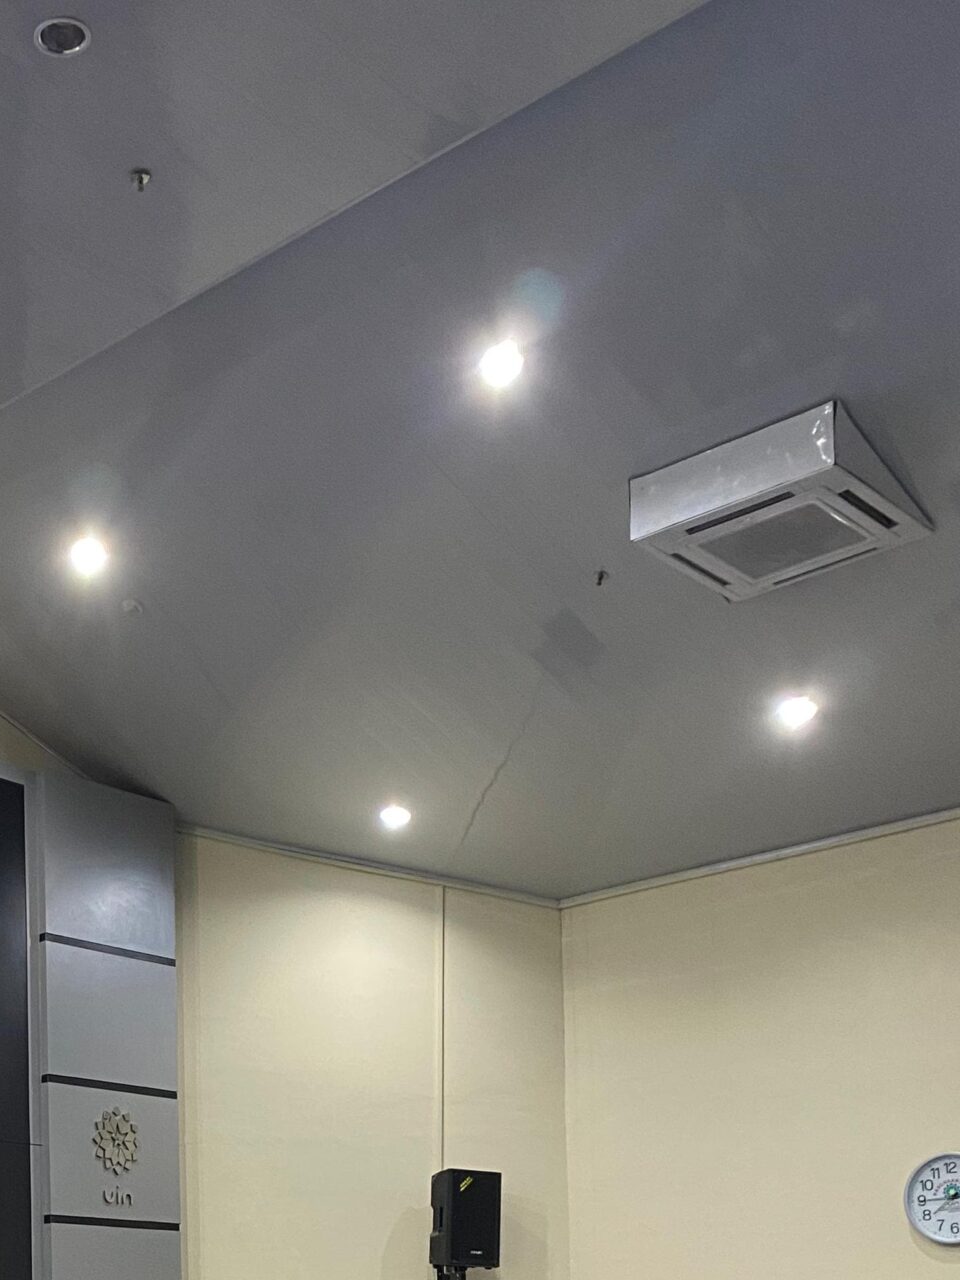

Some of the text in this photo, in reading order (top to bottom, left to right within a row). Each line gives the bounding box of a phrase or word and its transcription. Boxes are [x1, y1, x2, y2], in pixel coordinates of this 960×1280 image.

[930, 1167, 941, 1179] 11
[944, 1161, 957, 1174] 12
[920, 1179, 934, 1191] 10
[917, 1194, 926, 1206] 9
[922, 1209, 931, 1221] 8
[937, 1219, 945, 1231] 7
[950, 1222, 959, 1234] 6
